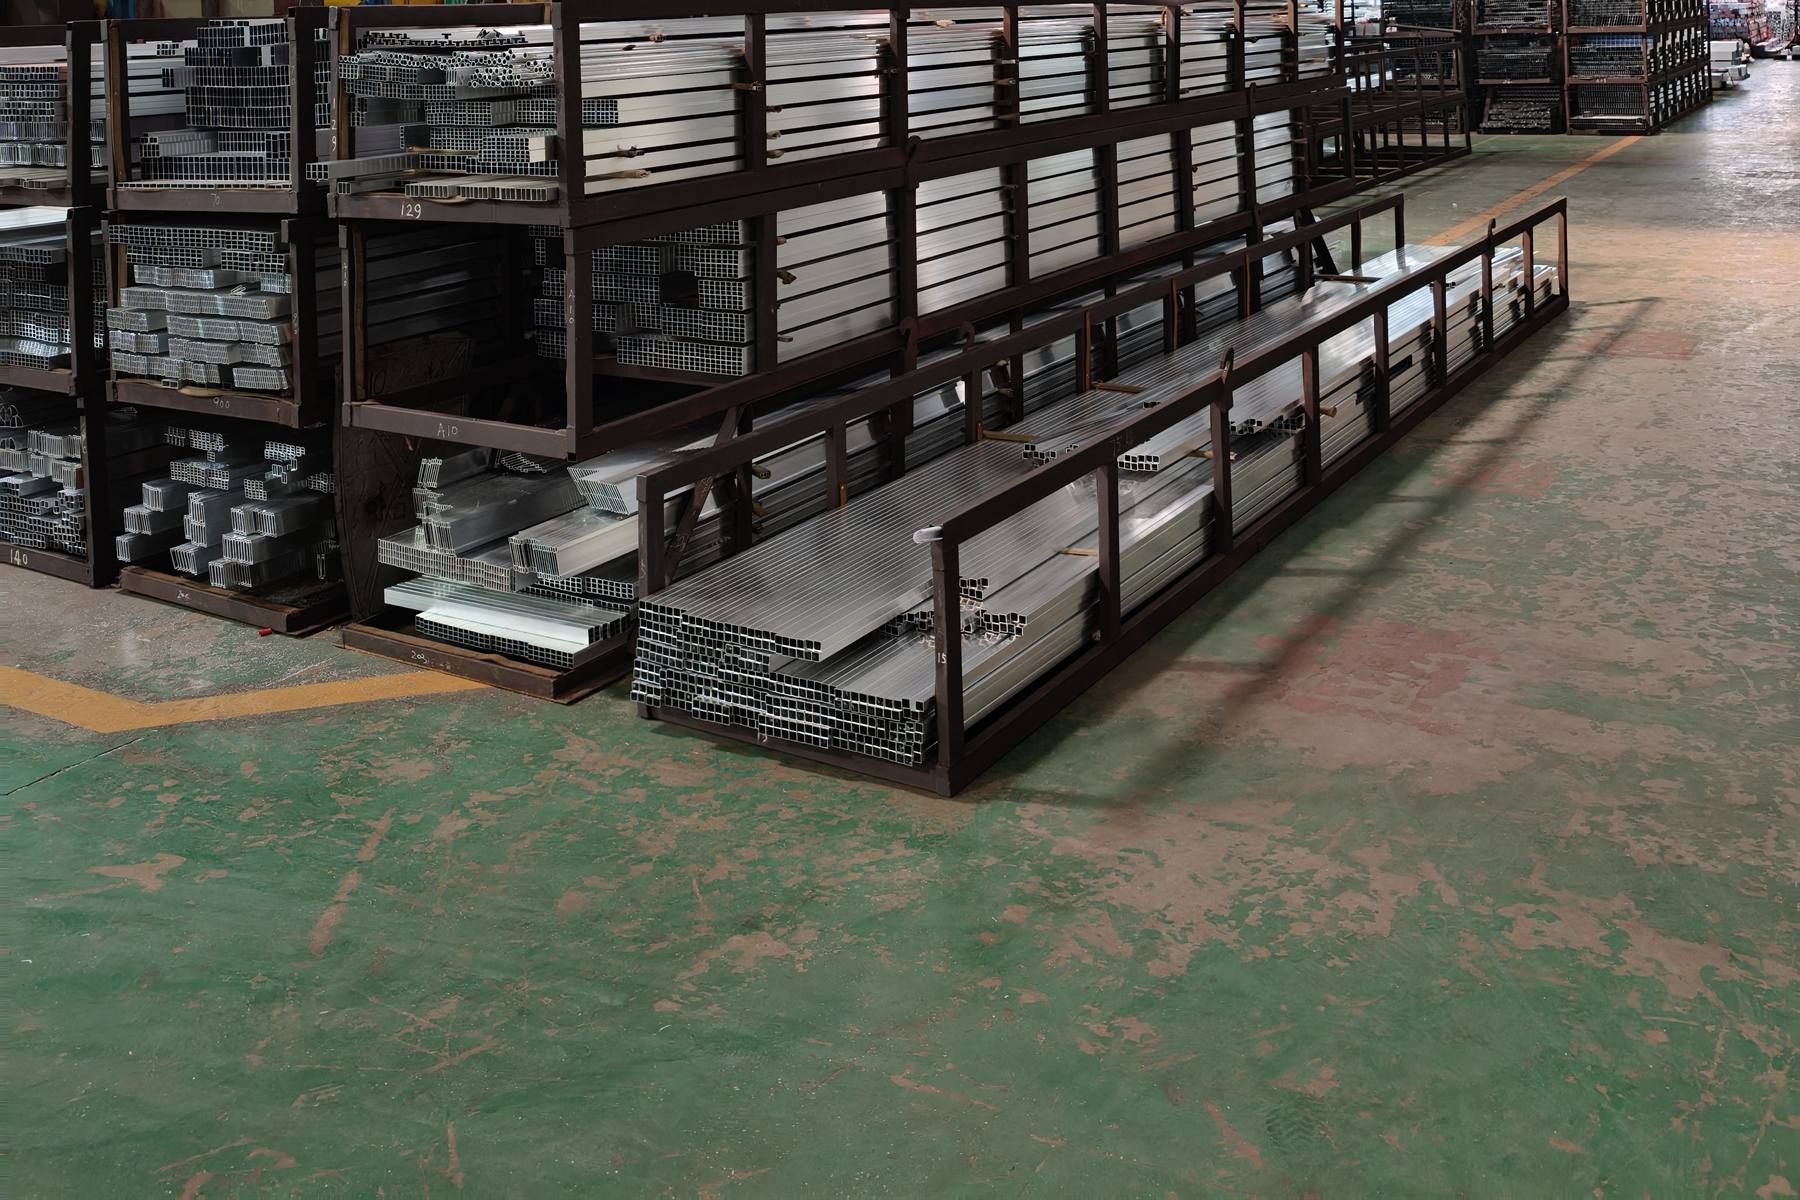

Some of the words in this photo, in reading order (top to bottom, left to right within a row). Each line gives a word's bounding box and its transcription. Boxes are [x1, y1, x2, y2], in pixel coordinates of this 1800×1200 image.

[401, 201, 422, 219] 129
[568, 289, 576, 324] A10
[212, 397, 231, 409] 900
[437, 422, 458, 439] A10
[10, 547, 28, 566] 140
[937, 652, 947, 664] 15
